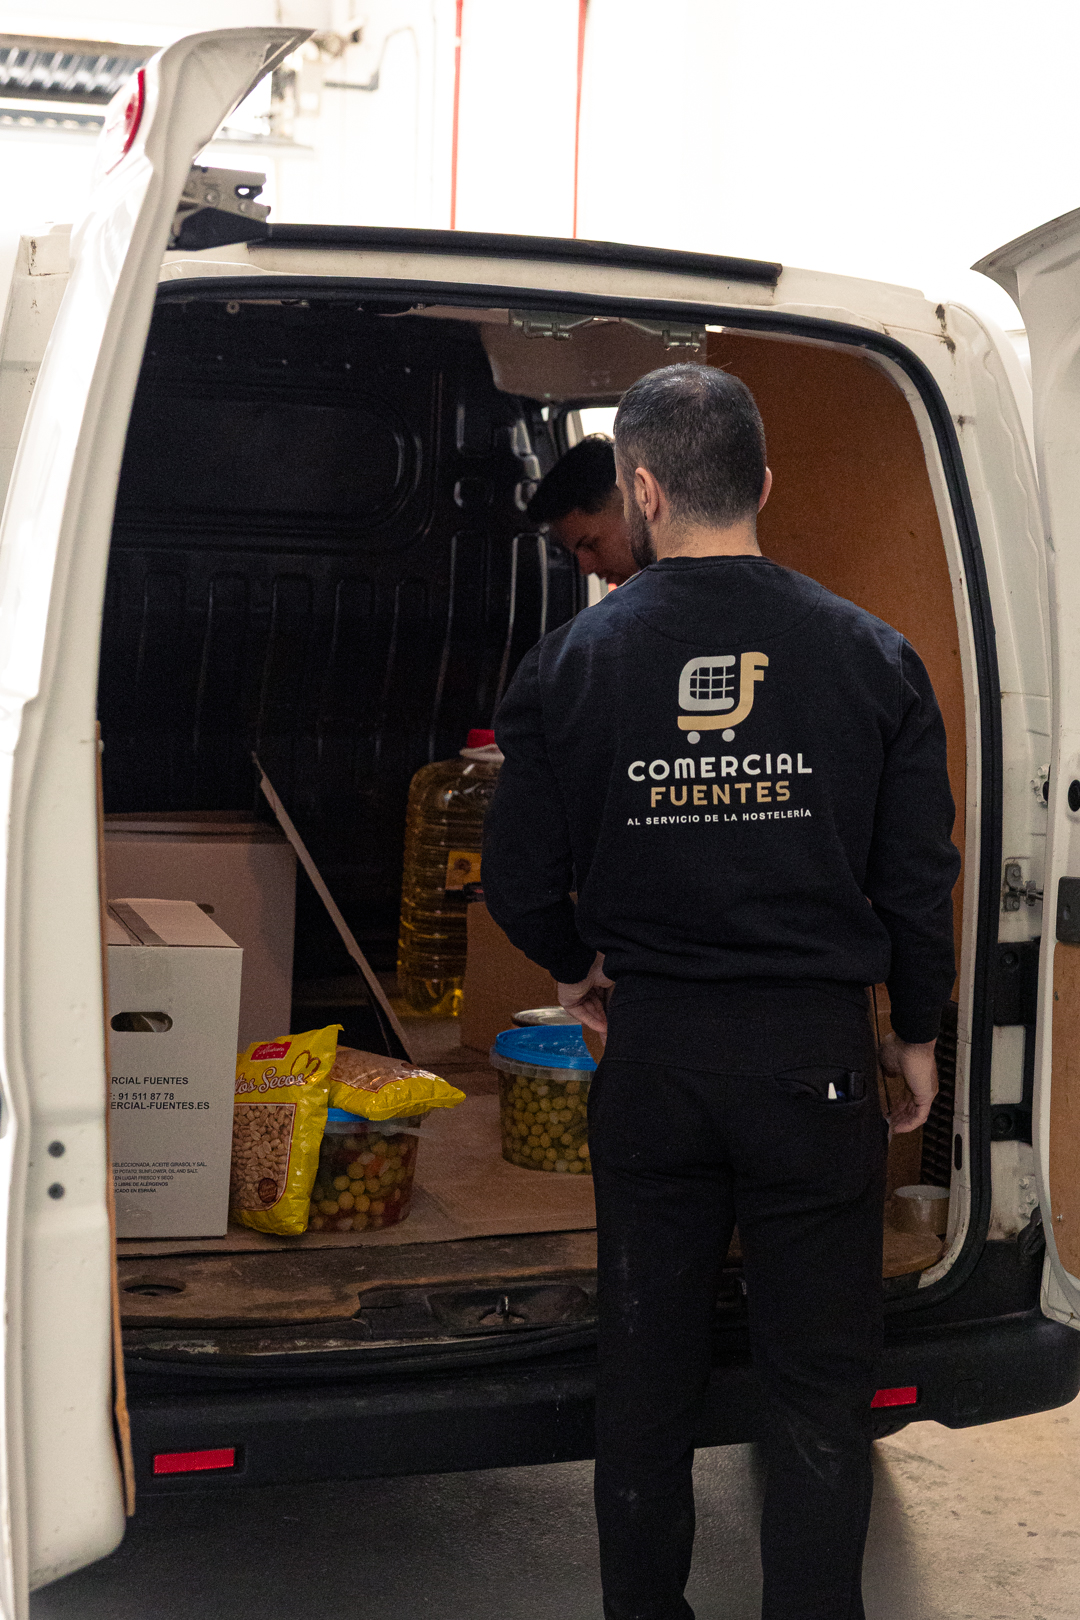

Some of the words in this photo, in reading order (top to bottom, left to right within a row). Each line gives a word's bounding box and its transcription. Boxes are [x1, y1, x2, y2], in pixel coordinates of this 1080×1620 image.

[628, 753, 813, 782] COMERCIAL
[651, 781, 791, 808] FUENTES
[646, 815, 700, 825] SERVICIO
[724, 813, 738, 822] LA
[743, 808, 812, 820] HOSTELERÍA
[258, 1066, 308, 1094] Secos
